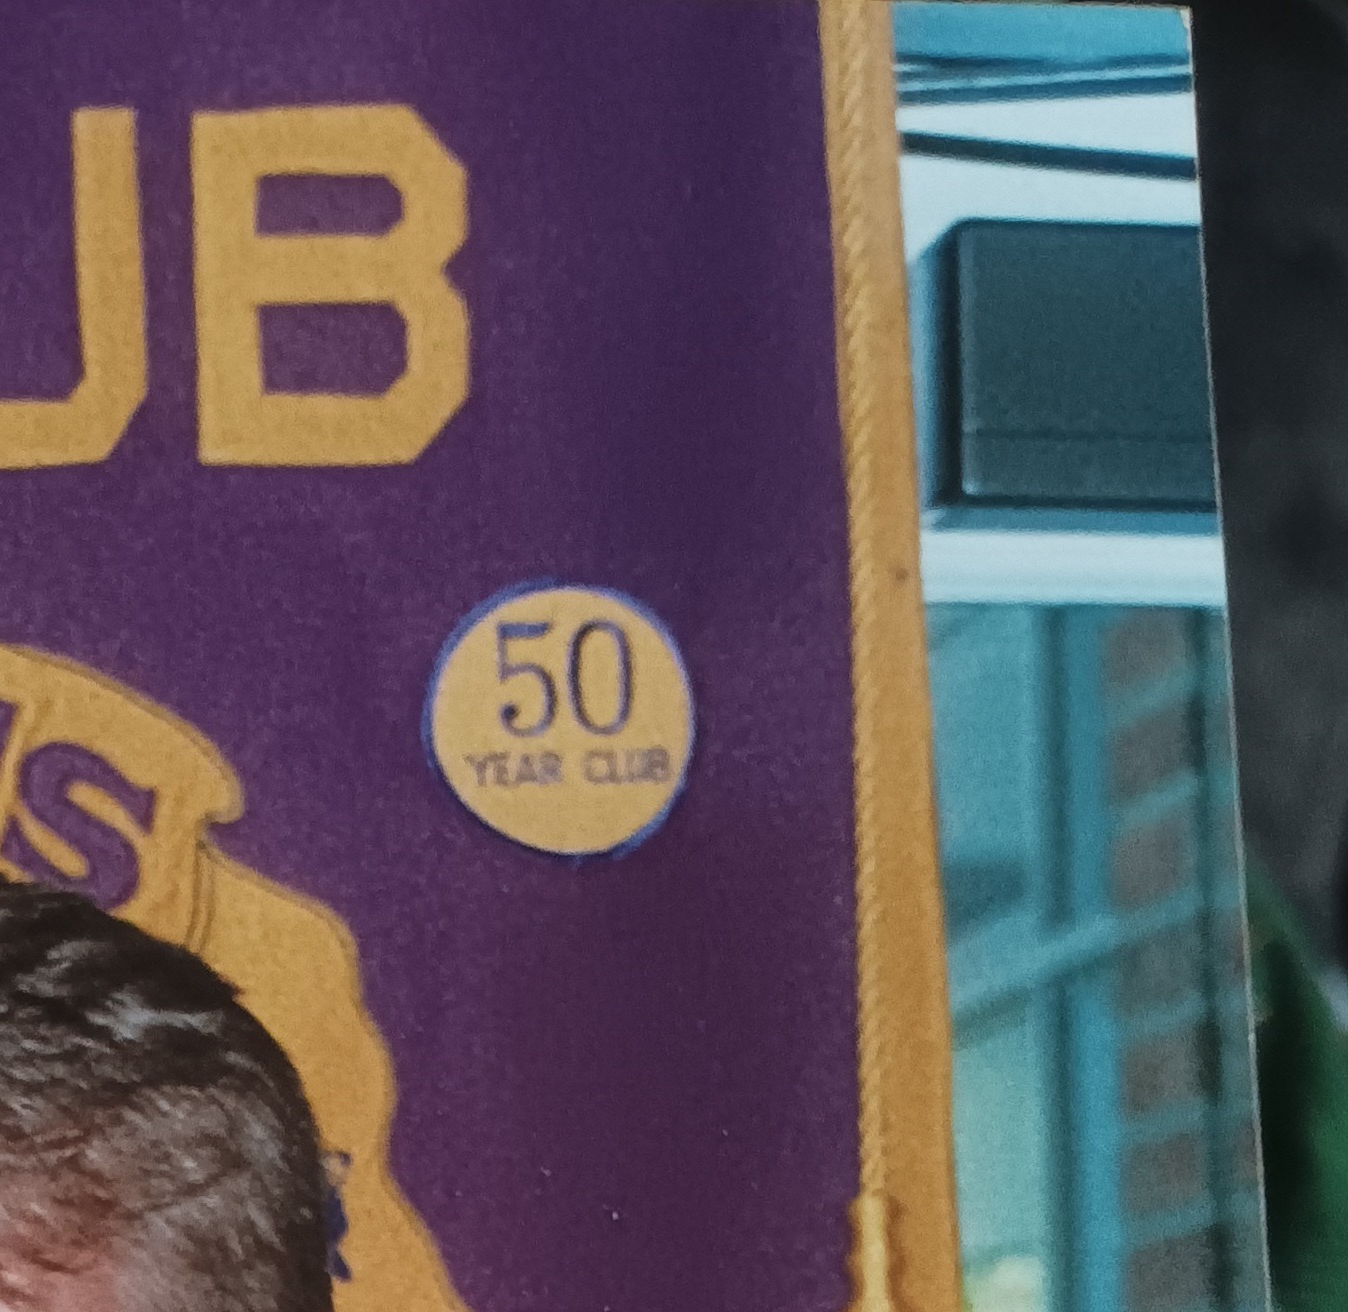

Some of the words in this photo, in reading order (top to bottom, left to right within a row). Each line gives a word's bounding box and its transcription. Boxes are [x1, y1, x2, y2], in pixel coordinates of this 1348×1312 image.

[496, 619, 634, 738] 50
[462, 750, 563, 788] YEAR
[583, 745, 674, 786] CLUB
